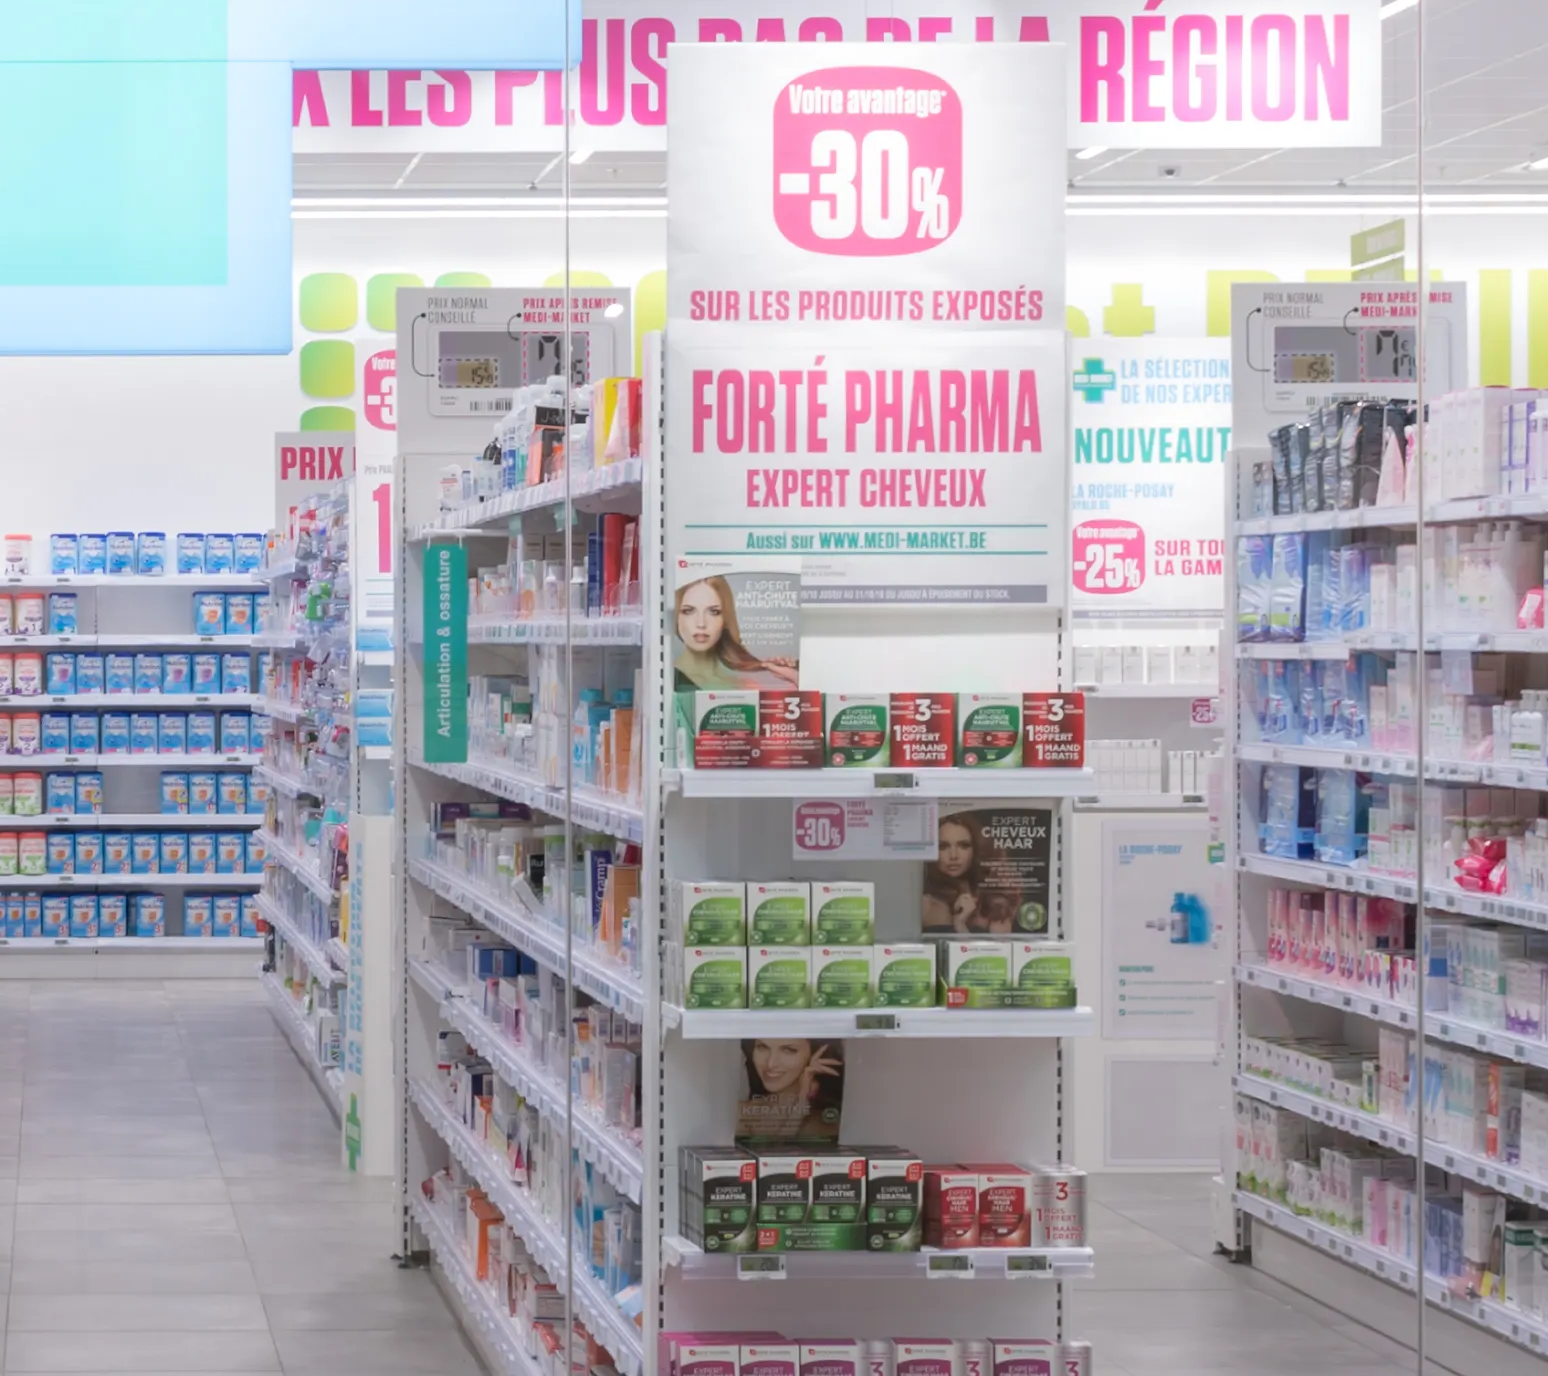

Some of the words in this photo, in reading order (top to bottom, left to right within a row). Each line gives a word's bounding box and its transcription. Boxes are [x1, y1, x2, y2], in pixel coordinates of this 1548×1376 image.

[496, 17, 667, 127] PLUS
[789, 85, 843, 114] Votre
[779, 130, 949, 240] -30%
[428, 298, 449, 309] PRIX
[454, 298, 488, 309] NORMAL
[428, 311, 475, 323] CONSEILLÉ
[523, 298, 546, 309] PRIX
[690, 291, 739, 322] SUR
[748, 291, 790, 322] LES
[798, 290, 924, 321] PRODUITS
[933, 284, 1043, 321] EXPOSÉS
[693, 356, 827, 453] FORTÉ
[845, 370, 1042, 453] PHARMA
[1075, 427, 1231, 463] NOUVEAUT
[281, 447, 343, 480] PRIX
[747, 470, 851, 508] EXPERT
[860, 470, 986, 508] CHEVEUX
[1088, 484, 1174, 498] ROCHE-POSAY
[820, 532, 987, 550] WWW.MEDI-MARKET.BE
[1074, 544, 1140, 588] -25%
[439, 550, 452, 620] ossature
[746, 581, 791, 590] EXPERT
[438, 622, 451, 638] &
[438, 644, 452, 738] Articulation
[1045, 744, 1080, 752] MAAND
[797, 818, 840, 847] -30%
[981, 827, 1046, 838] CHEVEUX
[992, 817, 1037, 826] EXPERT
[994, 839, 1032, 849] HAAR
